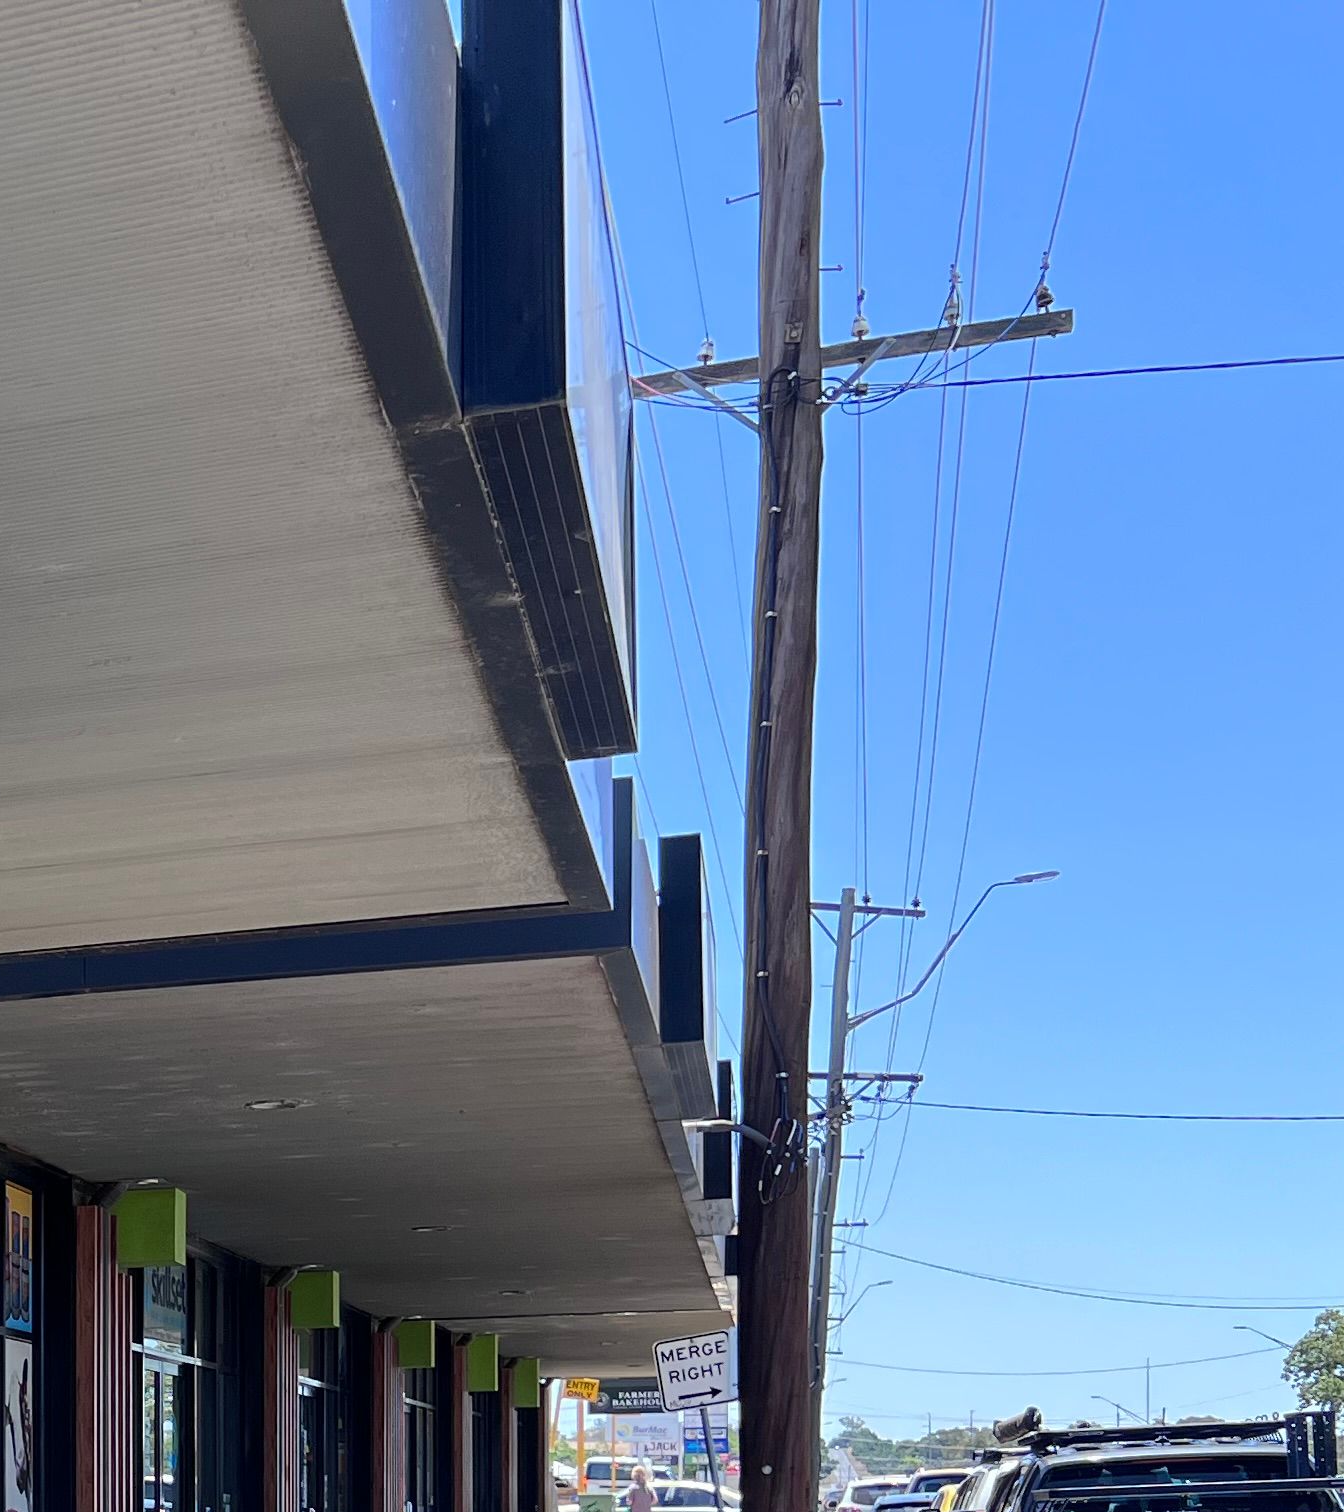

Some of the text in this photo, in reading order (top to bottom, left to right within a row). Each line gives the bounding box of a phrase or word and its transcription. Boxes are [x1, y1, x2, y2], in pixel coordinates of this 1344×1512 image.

[660, 1340, 727, 1364] MERGE
[669, 1362, 725, 1384] RIGHT
[566, 1380, 597, 1391] ENTRY
[567, 1389, 593, 1399] ONLY
